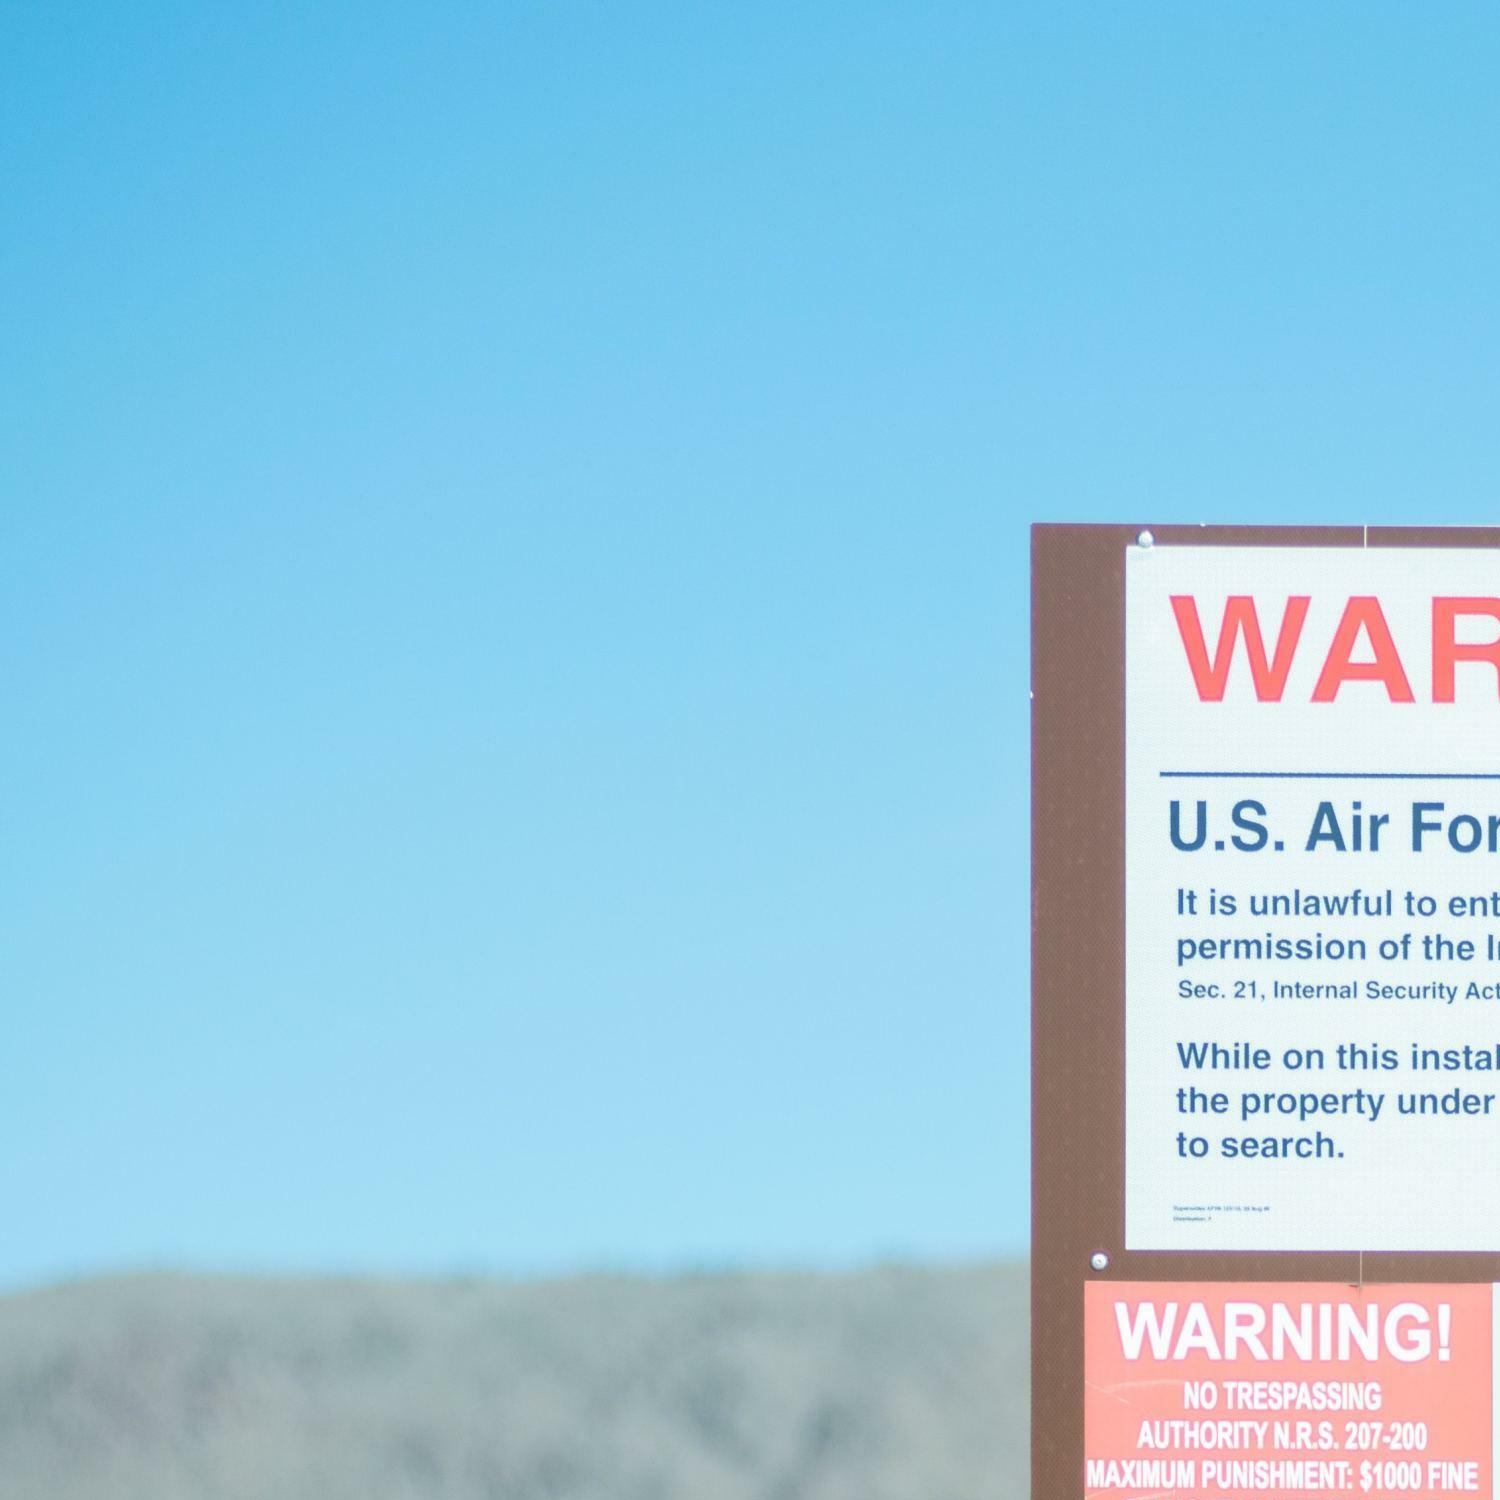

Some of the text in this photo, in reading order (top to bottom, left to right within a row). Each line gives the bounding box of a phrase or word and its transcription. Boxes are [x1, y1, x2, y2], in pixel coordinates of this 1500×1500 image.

[1169, 798, 1285, 853] U.S.
[1304, 800, 1390, 853] Air
[1177, 887, 1198, 916] It
[1209, 887, 1238, 917] is
[1249, 888, 1393, 917] unlawful
[1403, 890, 1438, 918] to
[1176, 932, 1367, 968] permission
[1378, 932, 1412, 961] of
[1421, 932, 1476, 962] the
[1177, 978, 1227, 1000] Sec.
[1232, 979, 1266, 1003] 21,
[1272, 979, 1358, 1000] Internal
[1365, 979, 1459, 1006] Security
[1175, 1041, 1272, 1071] While
[1282, 1048, 1325, 1071] on
[1335, 1042, 1400, 1071] this
[1175, 1085, 1230, 1115] the
[1241, 1088, 1386, 1123] property
[1397, 1087, 1496, 1116] under
[1175, 1130, 1345, 1159] to search.
[1114, 1301, 1451, 1362] WARNING!
[1183, 1380, 1382, 1411] NO TRESPASSING
[1136, 1420, 1428, 1451] AUTHORITY N.R.S. 207-200
[1086, 1459, 1479, 1493] MAXIMUM PUNISHMENT: $1000 FINE
